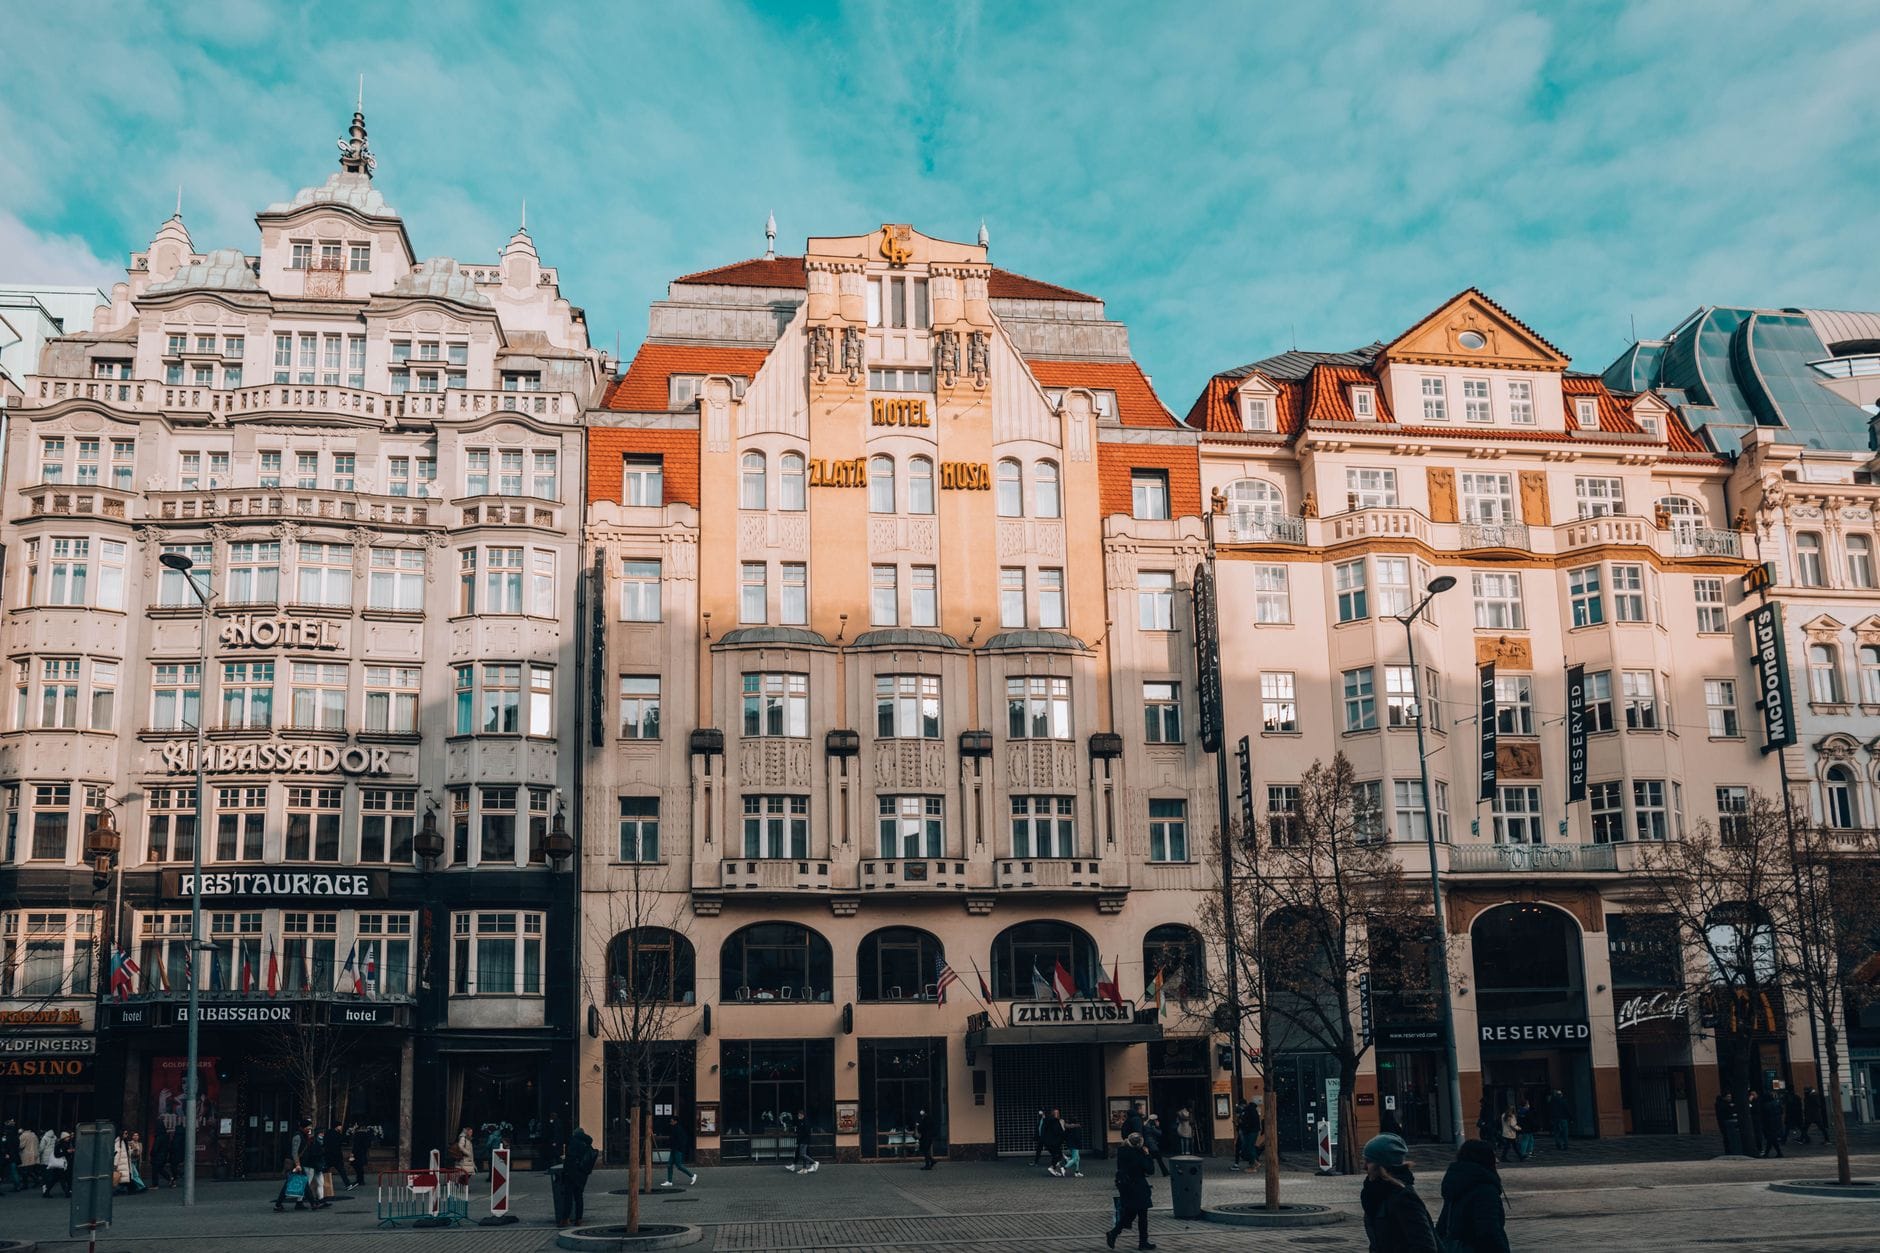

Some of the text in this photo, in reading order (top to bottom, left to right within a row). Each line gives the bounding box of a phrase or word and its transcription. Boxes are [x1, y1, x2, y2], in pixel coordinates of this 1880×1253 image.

[872, 398, 931, 427] HOTEL
[808, 457, 991, 490] ZLATÁ HUSA
[220, 613, 339, 648] HOTEL
[1758, 610, 1786, 741] McDonald's
[1481, 679, 1495, 781] MOHITO
[1572, 685, 1584, 785] RESERVED
[162, 740, 391, 777] AMBASSADOR
[181, 872, 369, 896] RESTAURACE
[122, 1010, 142, 1022] hotel
[346, 1009, 377, 1021] hotel
[1018, 1004, 1129, 1022] ZLATÁ HUSA
[1482, 1024, 1589, 1041] RESERVED
